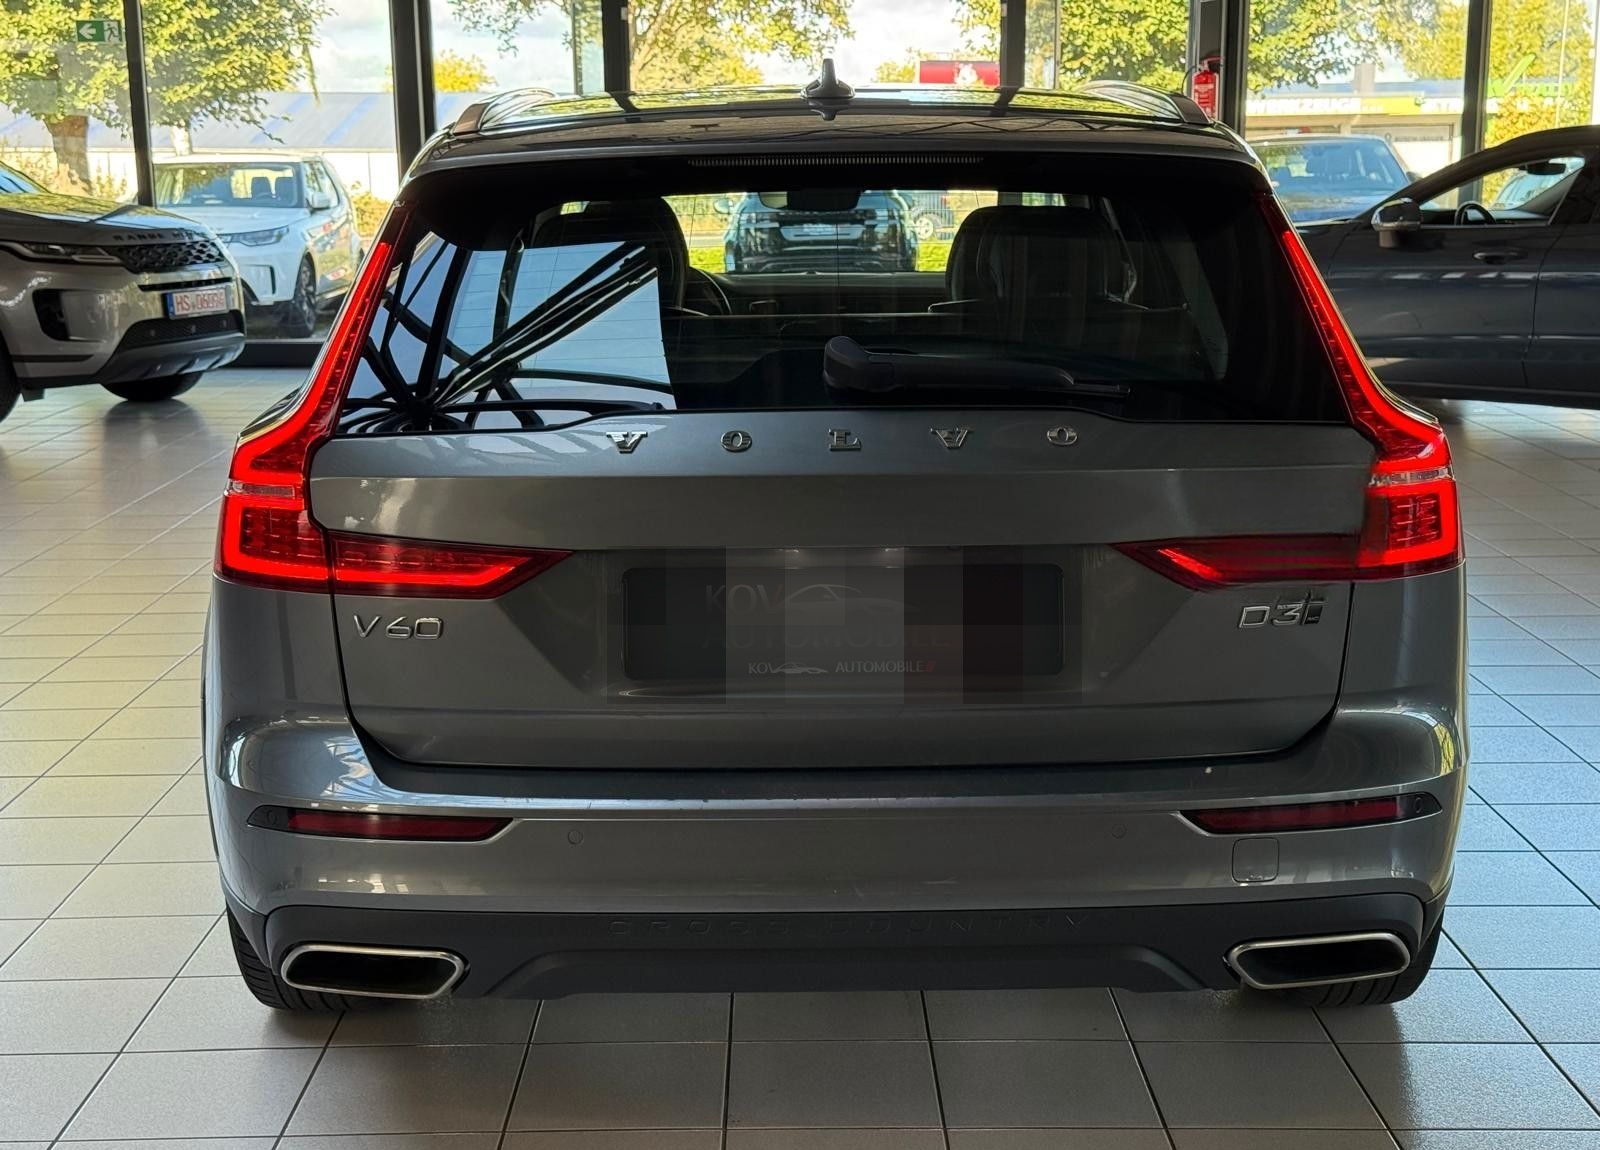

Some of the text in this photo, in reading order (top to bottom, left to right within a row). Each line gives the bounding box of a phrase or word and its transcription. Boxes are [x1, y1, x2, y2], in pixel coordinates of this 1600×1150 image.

[606, 427, 1078, 454] VOLVO
[353, 614, 442, 640] V60
[1239, 603, 1303, 628] D3
[608, 919, 790, 935] CROSS
